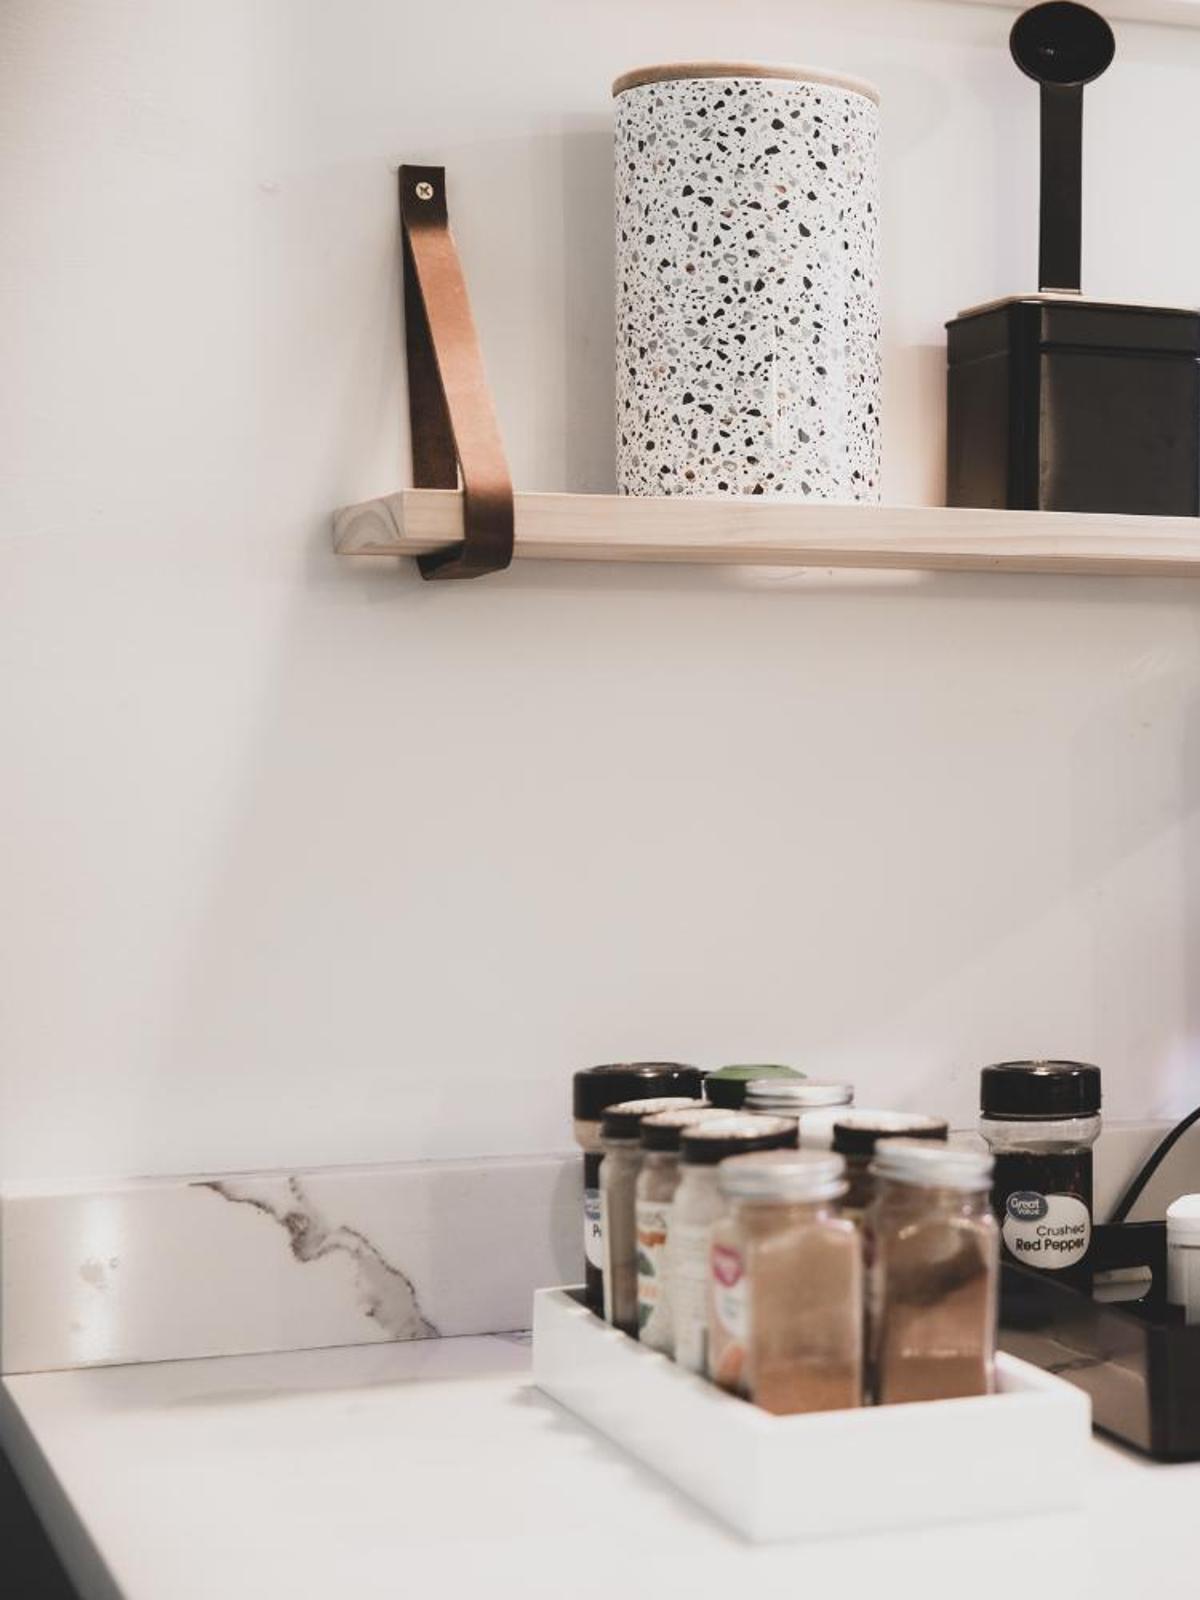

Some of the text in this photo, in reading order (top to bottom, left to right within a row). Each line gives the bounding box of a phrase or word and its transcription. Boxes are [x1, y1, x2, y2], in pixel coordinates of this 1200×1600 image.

[1010, 1197, 1040, 1209] Great
[1036, 1224, 1085, 1237] Crushed
[1015, 1238, 1085, 1253] Red Pepper
